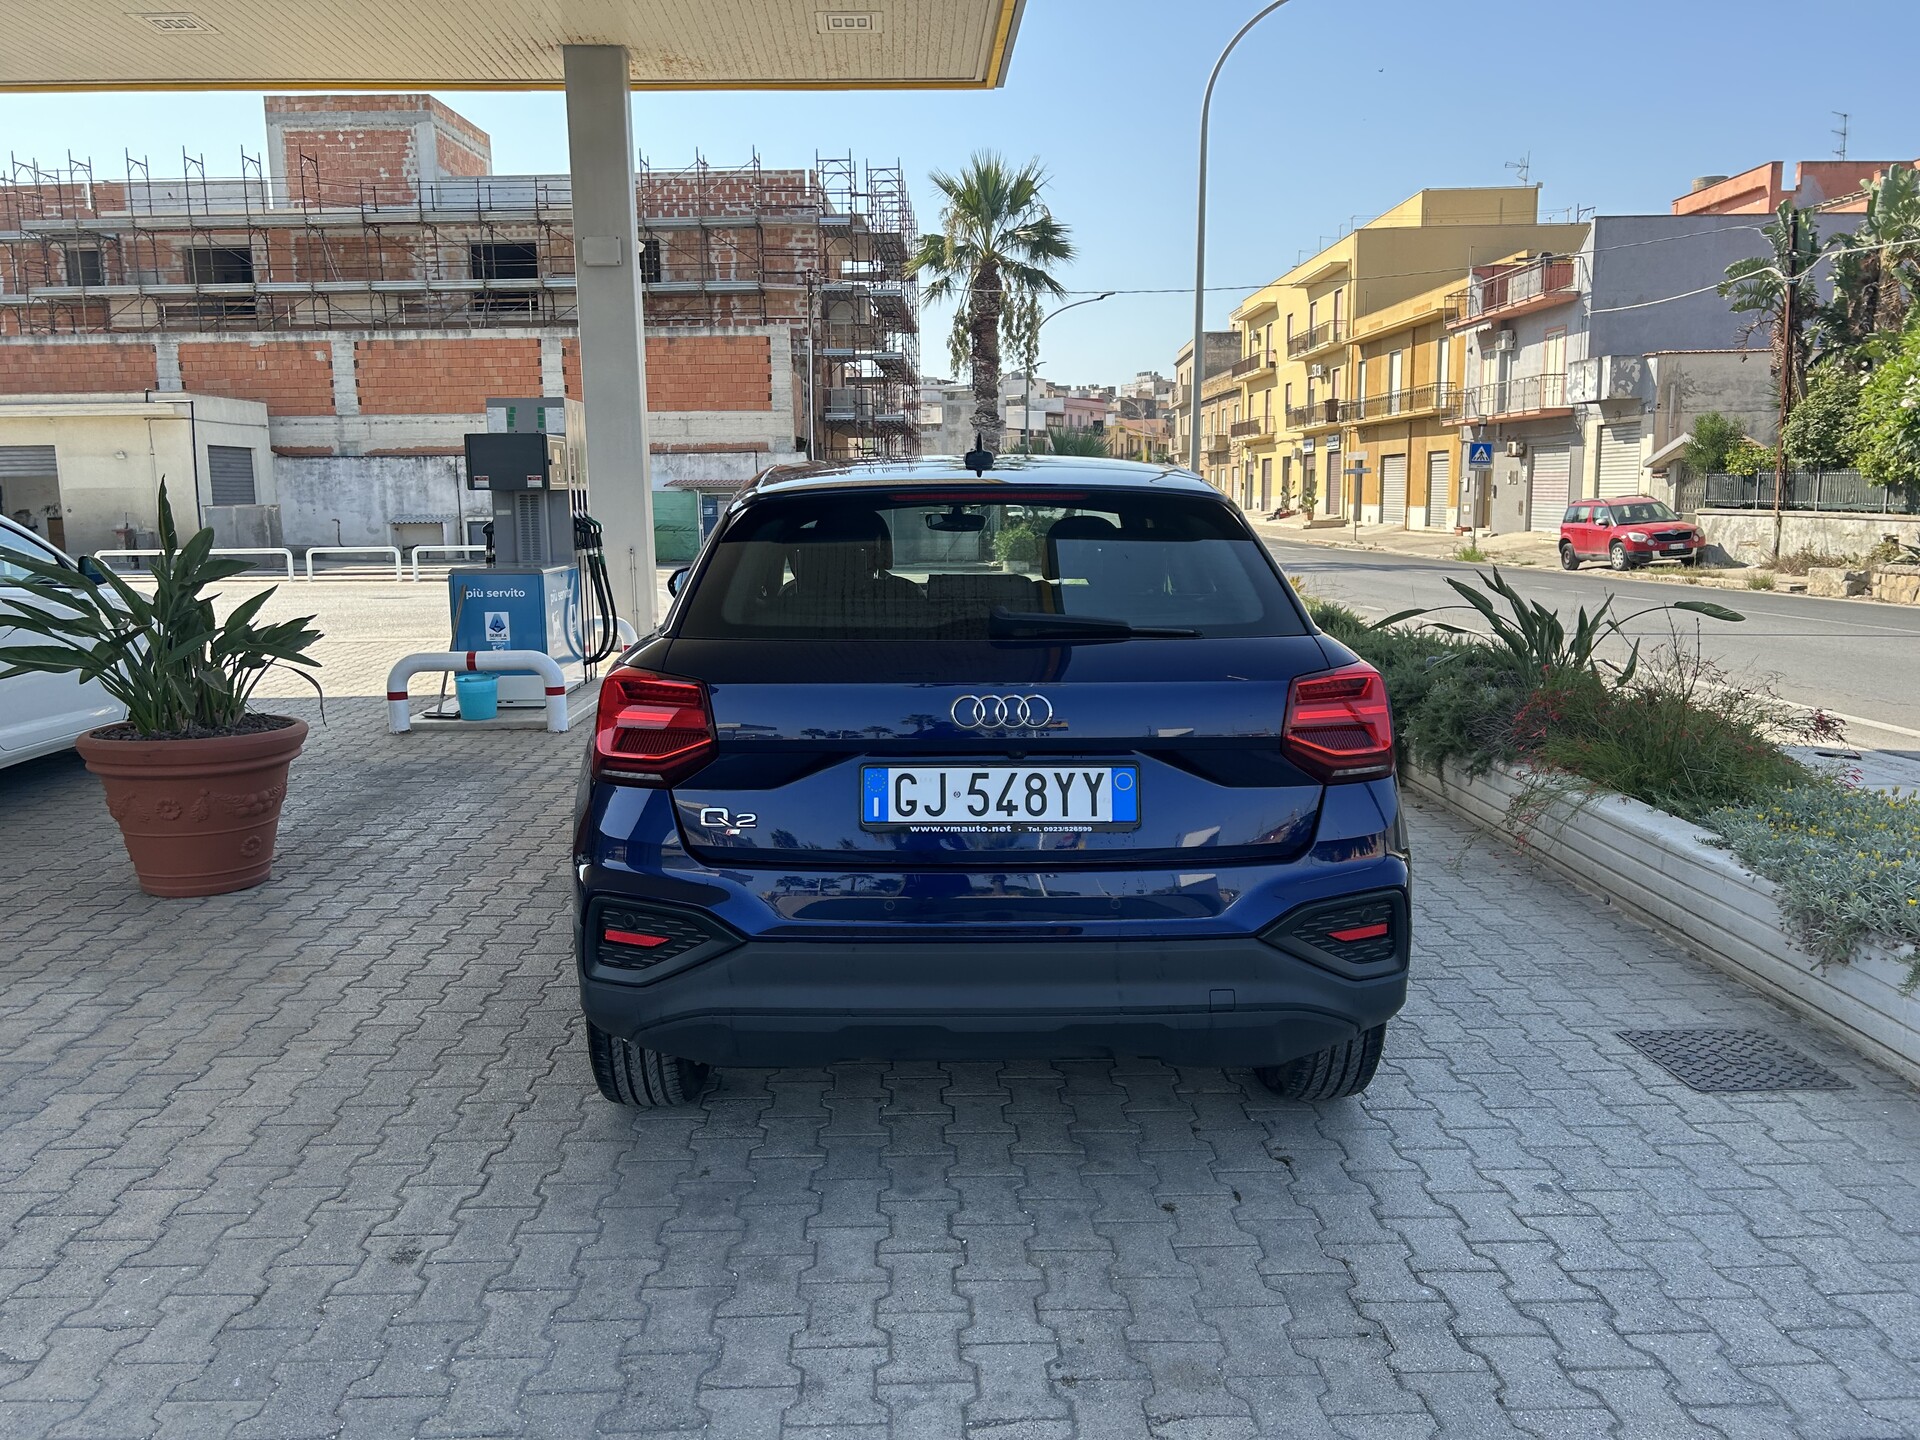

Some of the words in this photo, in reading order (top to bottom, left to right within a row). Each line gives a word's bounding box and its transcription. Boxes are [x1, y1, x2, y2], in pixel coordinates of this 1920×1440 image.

[466, 588, 484, 600] più
[486, 588, 526, 598] servito
[700, 807, 757, 828] Q2
[909, 825, 1012, 833] www.vmauto.net
